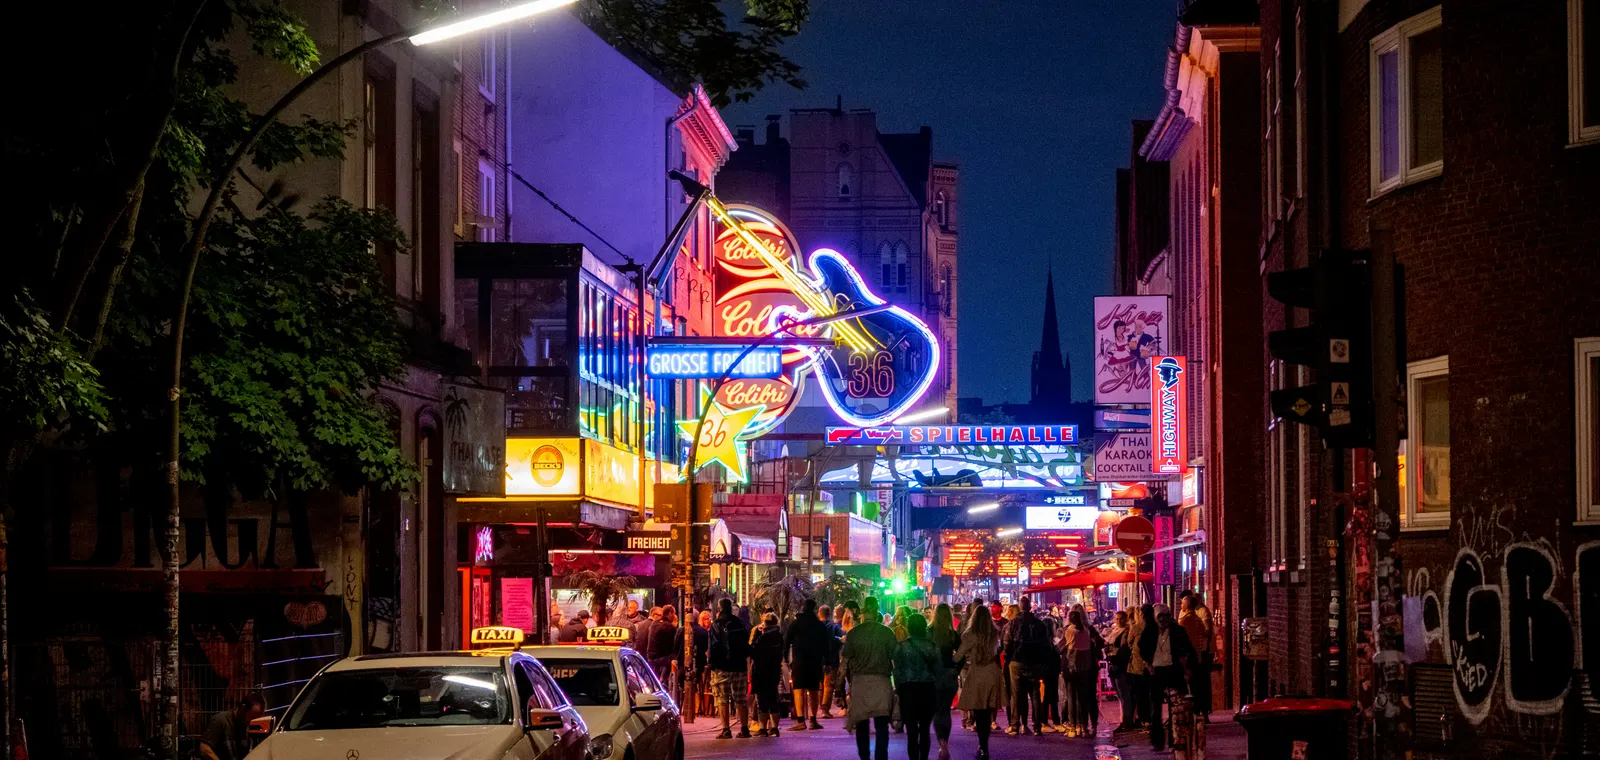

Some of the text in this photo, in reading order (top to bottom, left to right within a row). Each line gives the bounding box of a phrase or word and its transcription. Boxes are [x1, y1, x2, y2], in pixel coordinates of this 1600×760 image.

[722, 300, 820, 338] Colri
[650, 353, 780, 374] GROSSE FREIHEIT
[848, 351, 895, 397] 36
[725, 381, 788, 405] Colibri
[1163, 389, 1176, 458] HIGHWAY
[700, 419, 726, 448] 36
[909, 427, 1074, 442] SPIELHALLE
[1120, 437, 1148, 447] THAI
[1105, 450, 1152, 460] KARAOK
[1097, 464, 1145, 473] COCKTAIL
[633, 537, 671, 549] FREIHEIT
[479, 629, 513, 640] TAXI
[593, 628, 622, 638] TAXI
